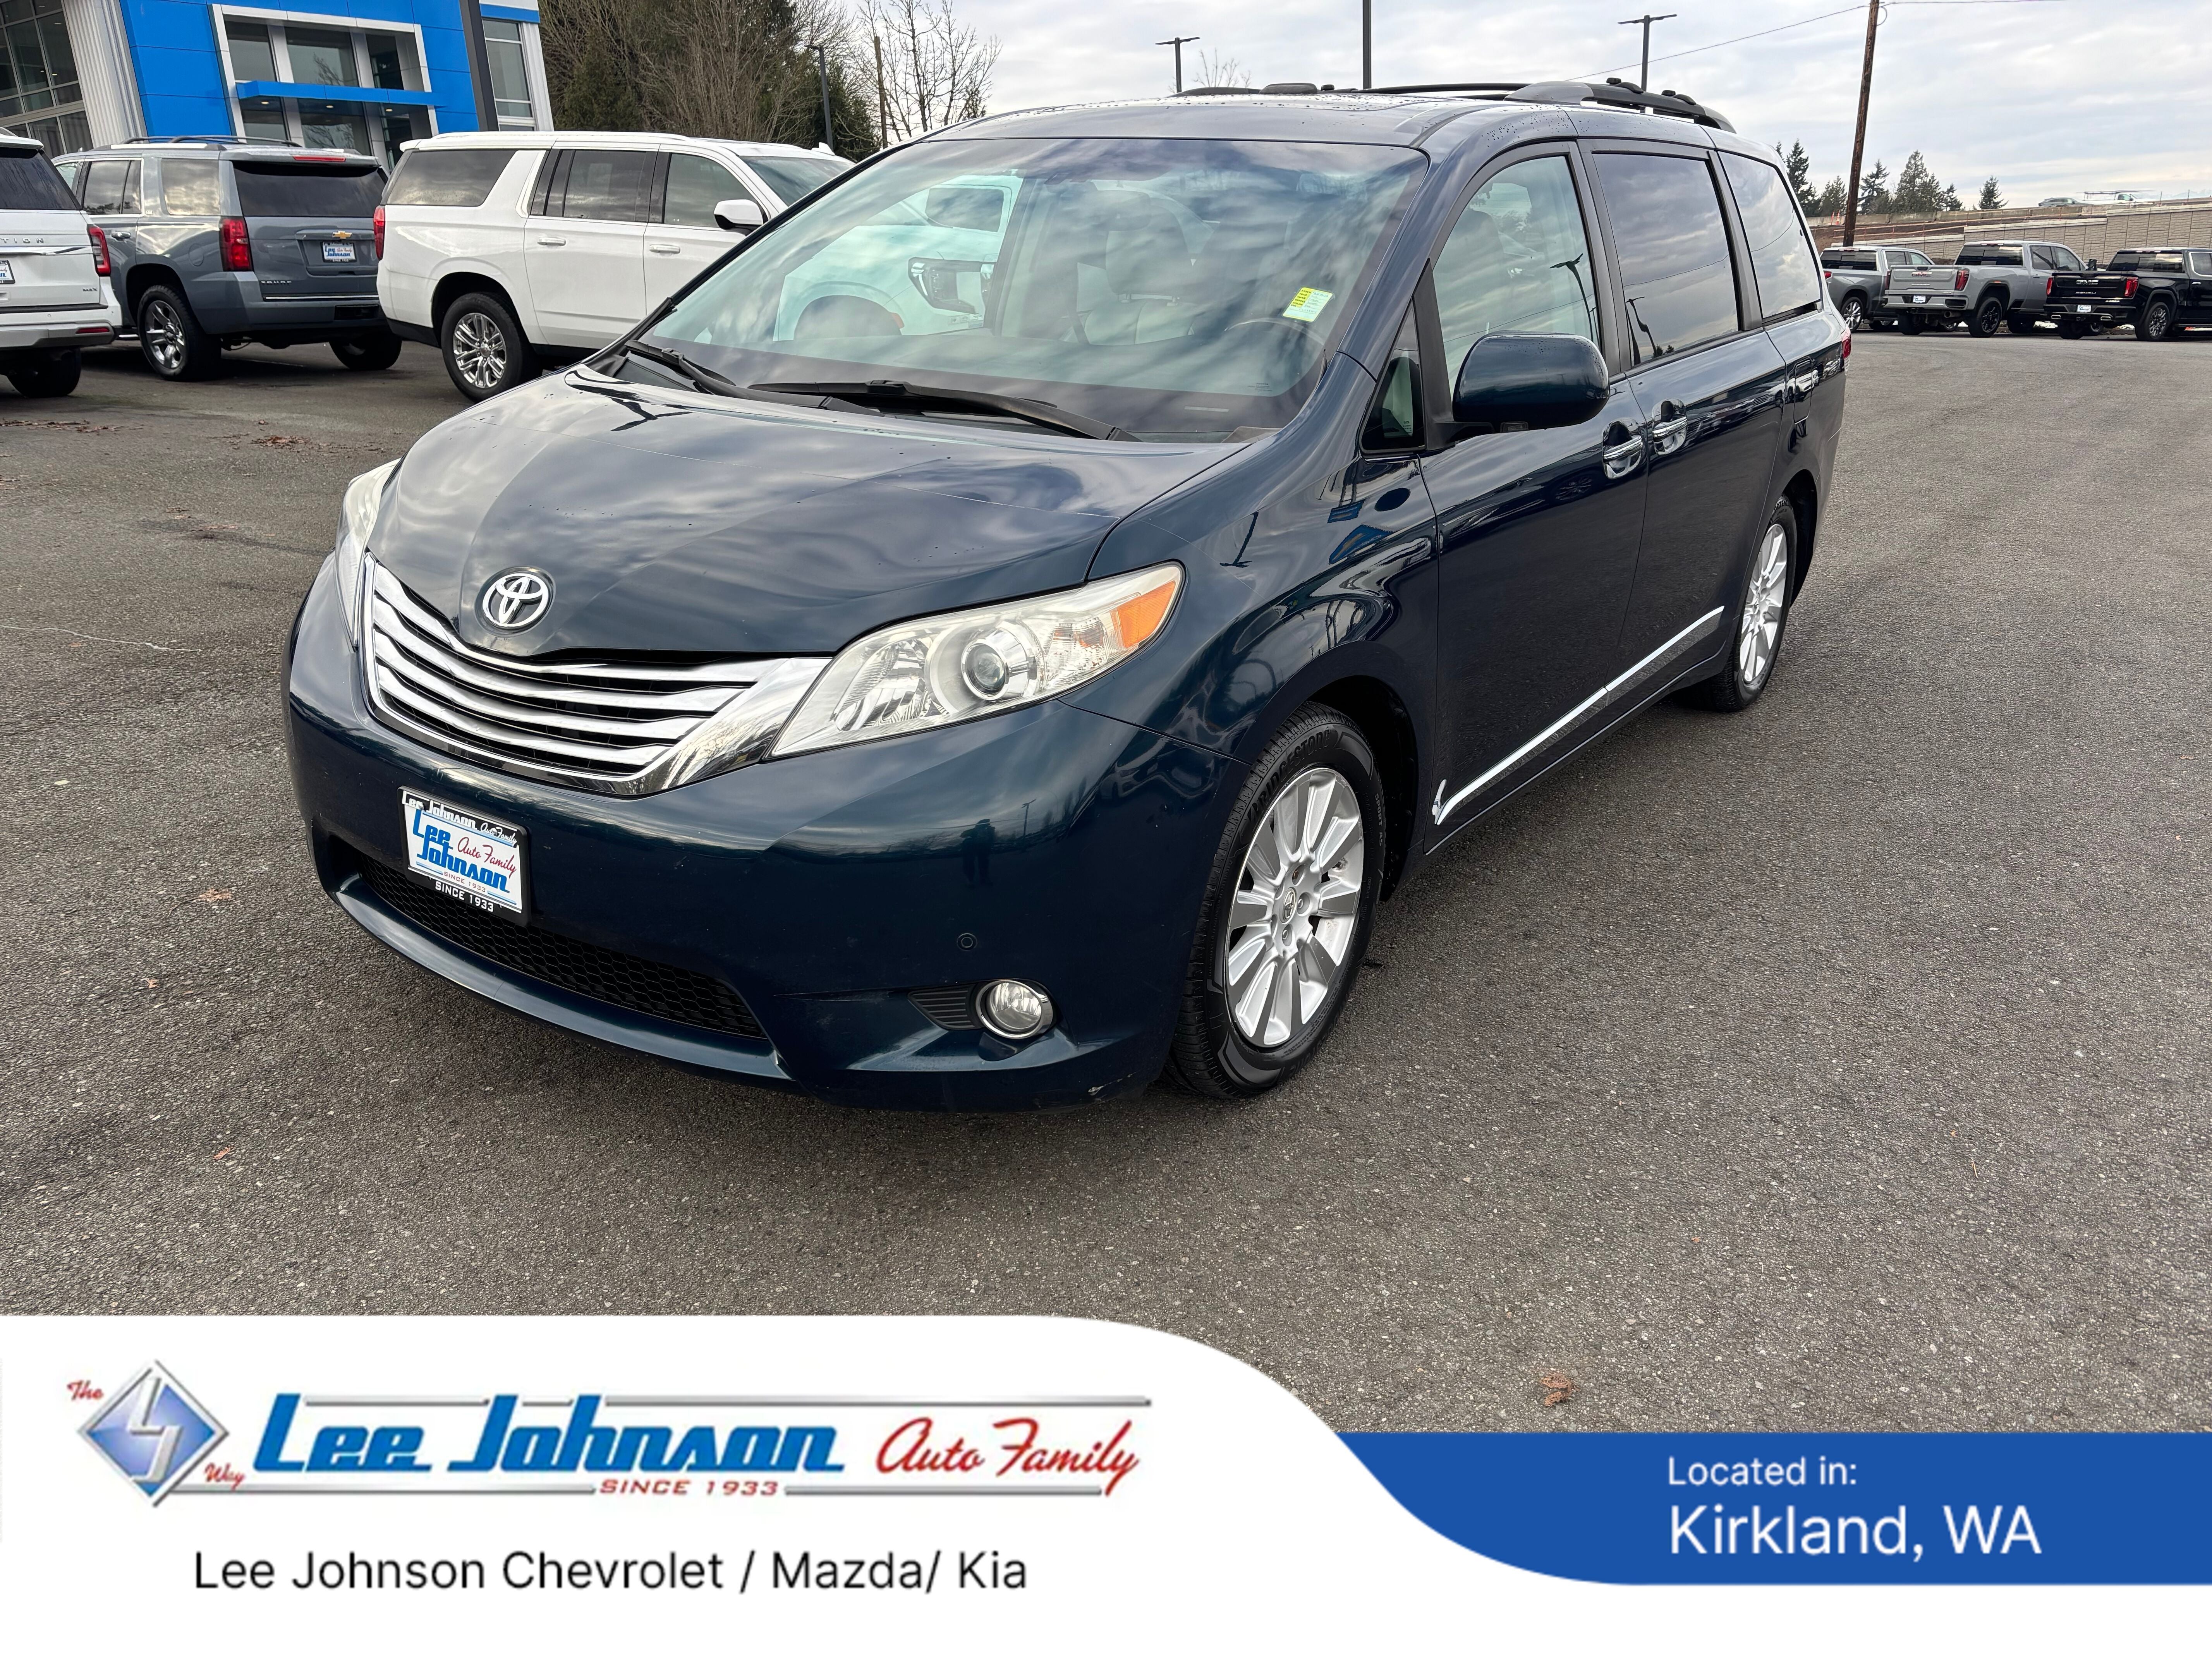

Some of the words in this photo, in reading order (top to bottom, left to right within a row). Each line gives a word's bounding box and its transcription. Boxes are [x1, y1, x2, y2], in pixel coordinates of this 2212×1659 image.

[413, 809, 453, 849] Lee
[458, 837, 481, 859] Auto
[483, 845, 517, 879] Family
[426, 800, 477, 830] Johnson
[496, 827, 517, 847] Family
[417, 838, 510, 893] Johnson
[444, 872, 465, 884] SINCE
[469, 881, 486, 893] 1933
[435, 881, 465, 900] SINCE
[469, 895, 494, 912] 1933
